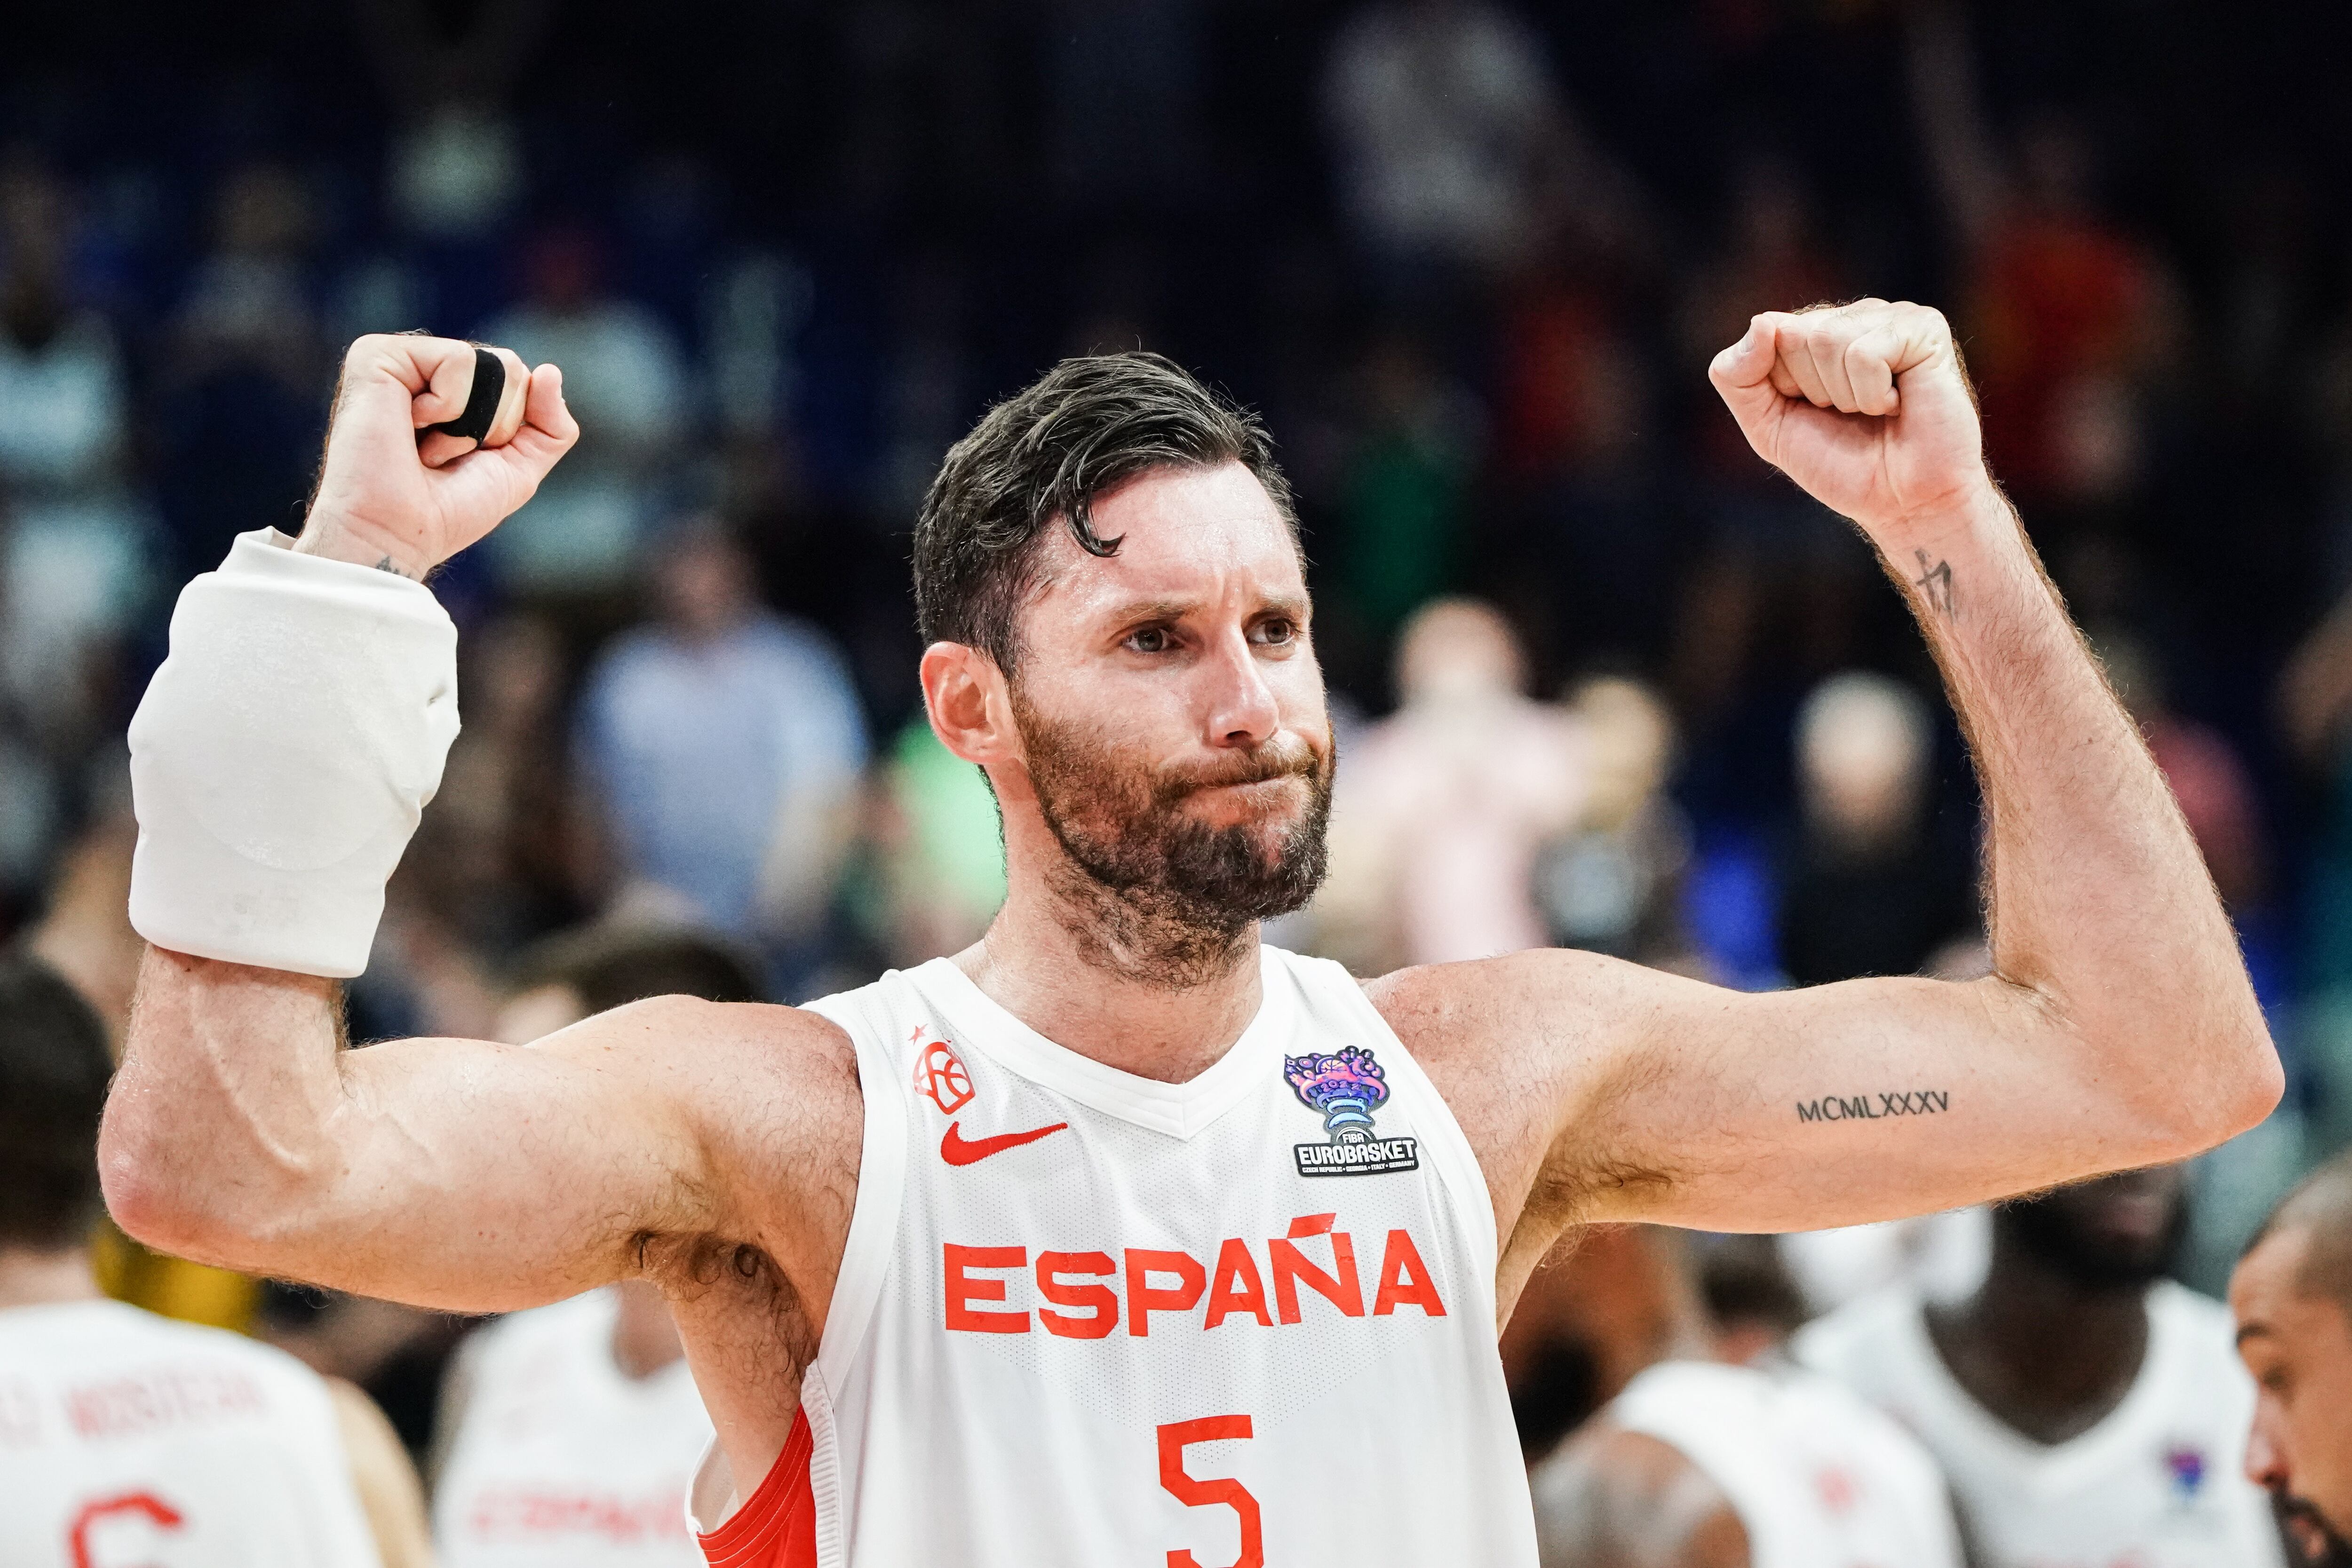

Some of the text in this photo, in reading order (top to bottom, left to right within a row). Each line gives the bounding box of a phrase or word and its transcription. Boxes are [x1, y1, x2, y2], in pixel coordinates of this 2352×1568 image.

[1796, 1091, 1948, 1123] MCMLXXXV
[1342, 1132, 1365, 1144] FIBA
[1297, 1140, 1414, 1165] EUROBASKET
[1388, 1160, 1415, 1169] GERMANY
[943, 1212, 1447, 1340] ESPAÑA
[1156, 1415, 1264, 1568] 5
